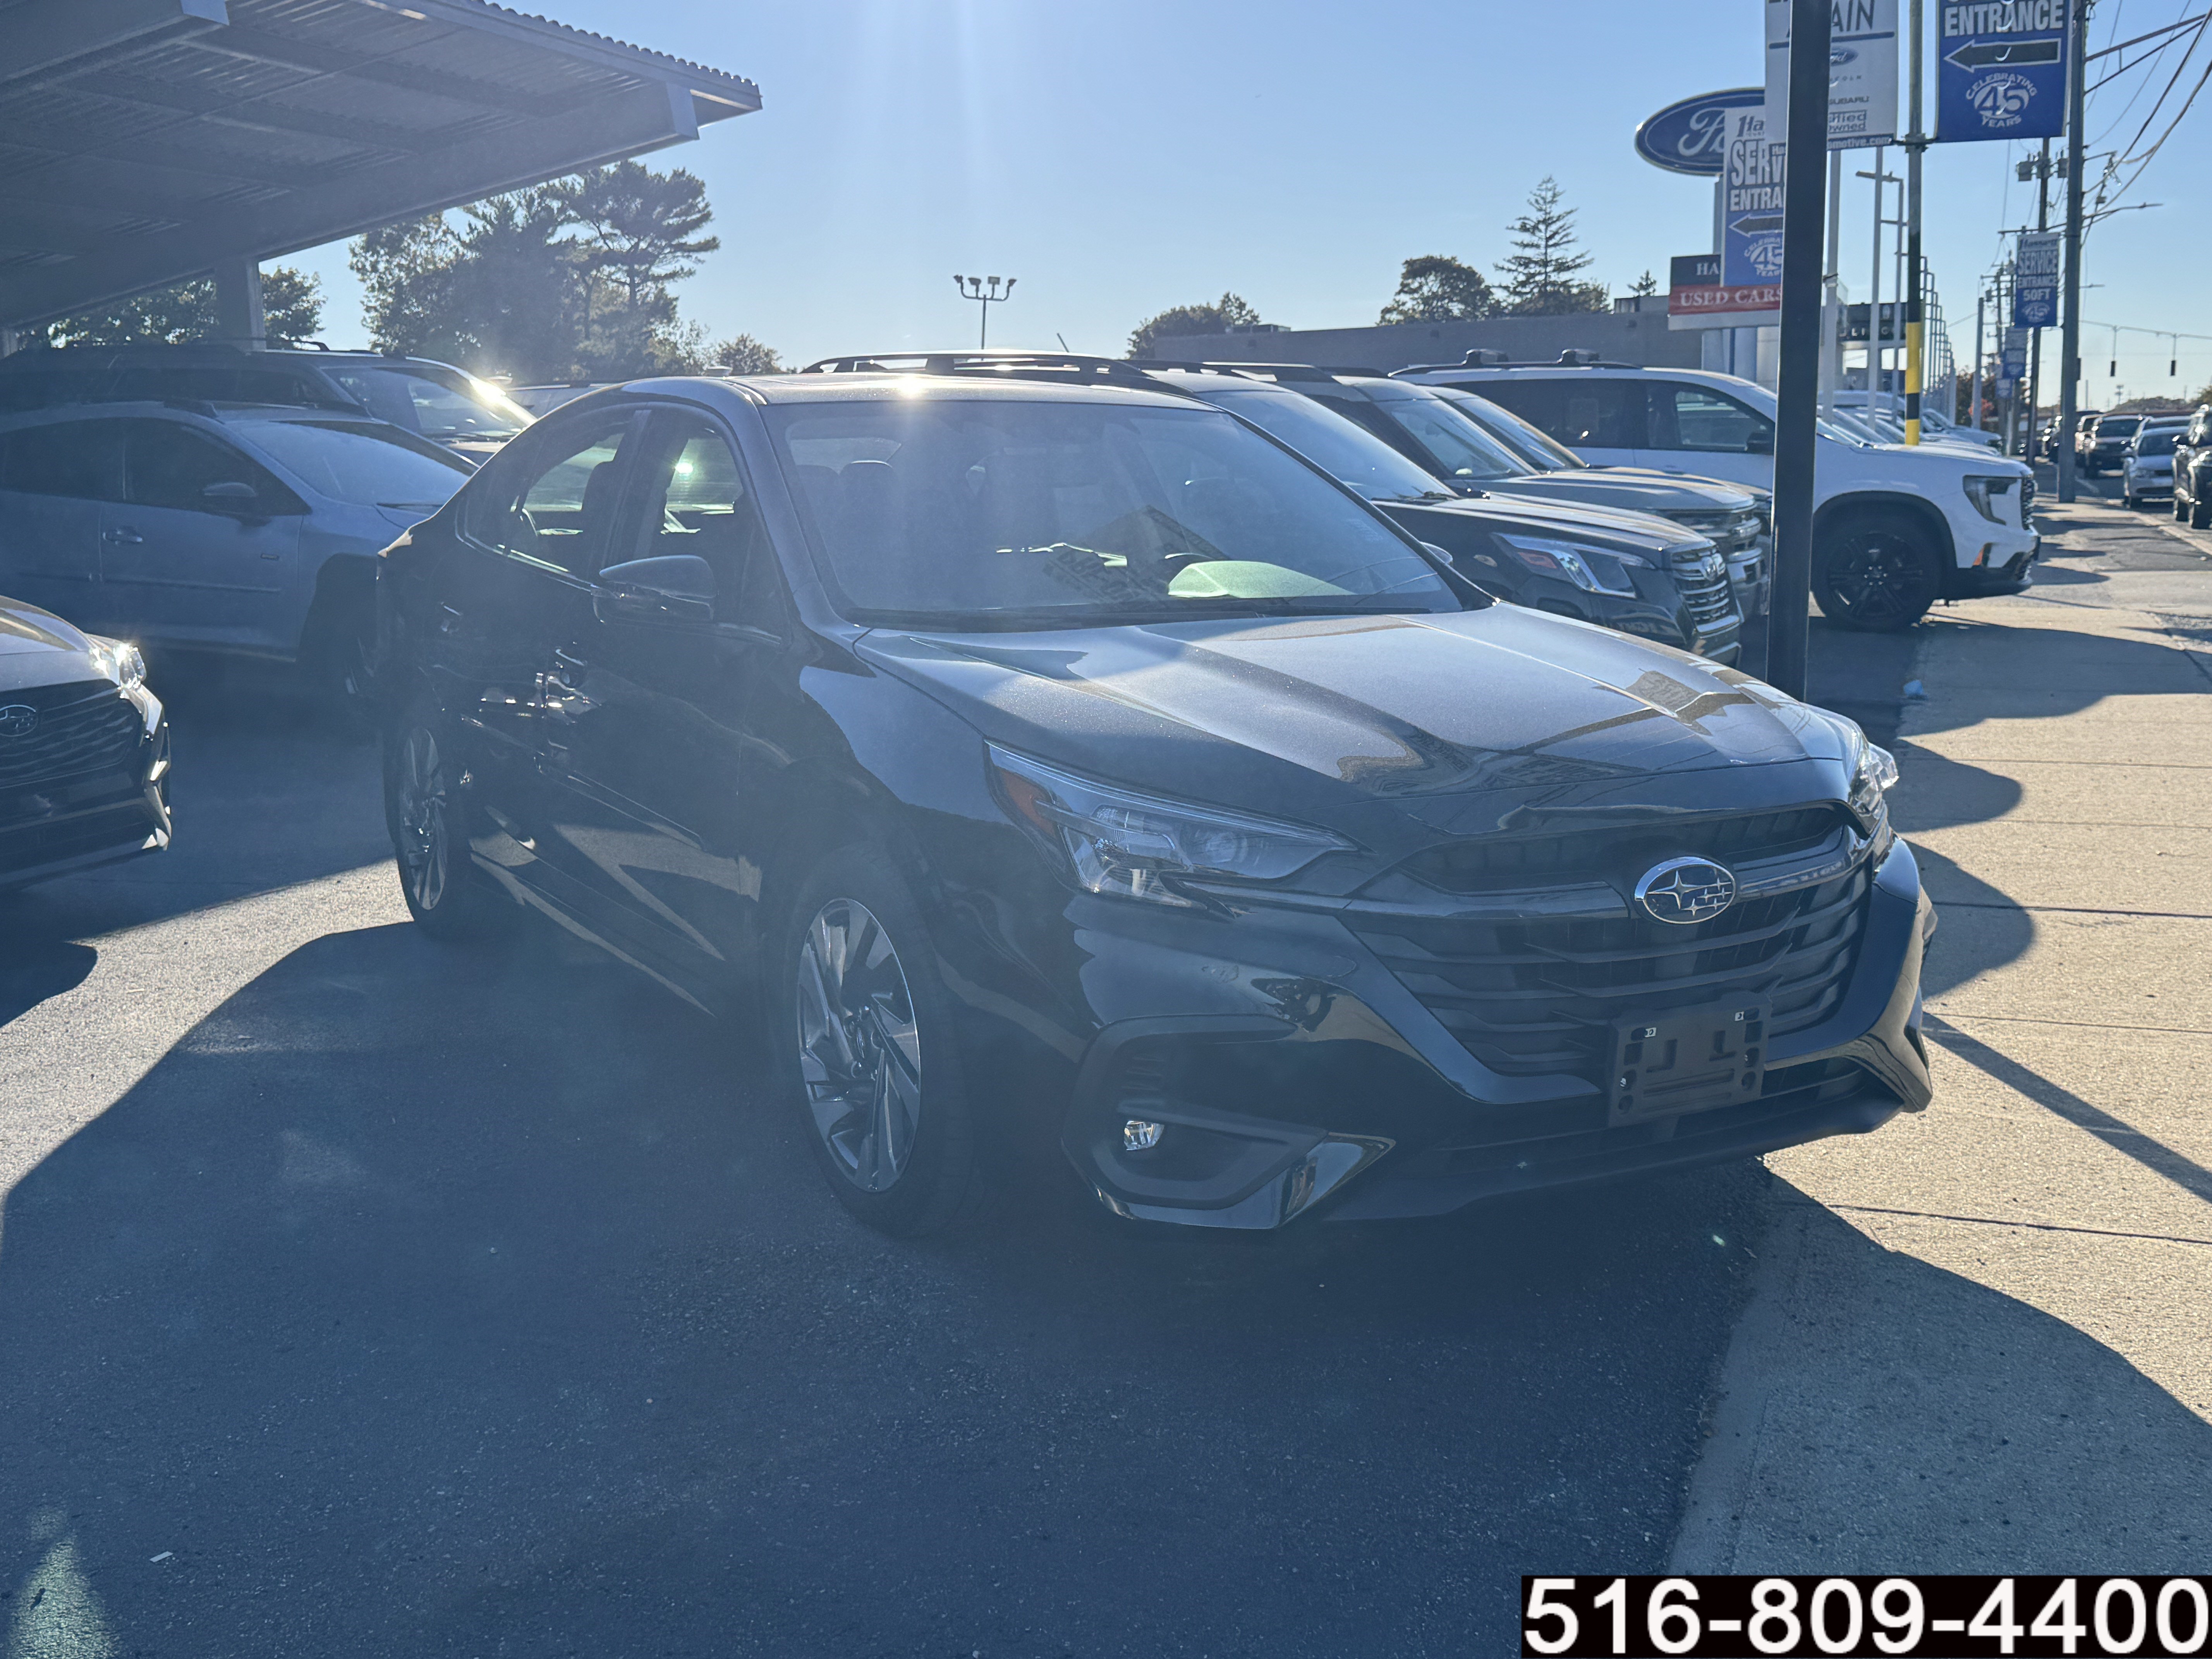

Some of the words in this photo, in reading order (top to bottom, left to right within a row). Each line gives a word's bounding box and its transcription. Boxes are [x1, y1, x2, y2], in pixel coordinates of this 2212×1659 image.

[1944, 0, 2064, 37] ENTRANCE
[1966, 72, 2038, 100] CELEBRATING
[1974, 82, 2030, 119] 45
[1981, 115, 2022, 128] YEARS
[1731, 140, 1784, 187] SERV
[1730, 186, 1783, 212] ENTRA
[1744, 237, 1781, 257] CELEBRA
[1756, 268, 1782, 277] YEAR
[2018, 251, 2057, 276] SERVICE
[2017, 274, 2057, 289] ENTRANCE
[1680, 291, 1729, 306] USED
